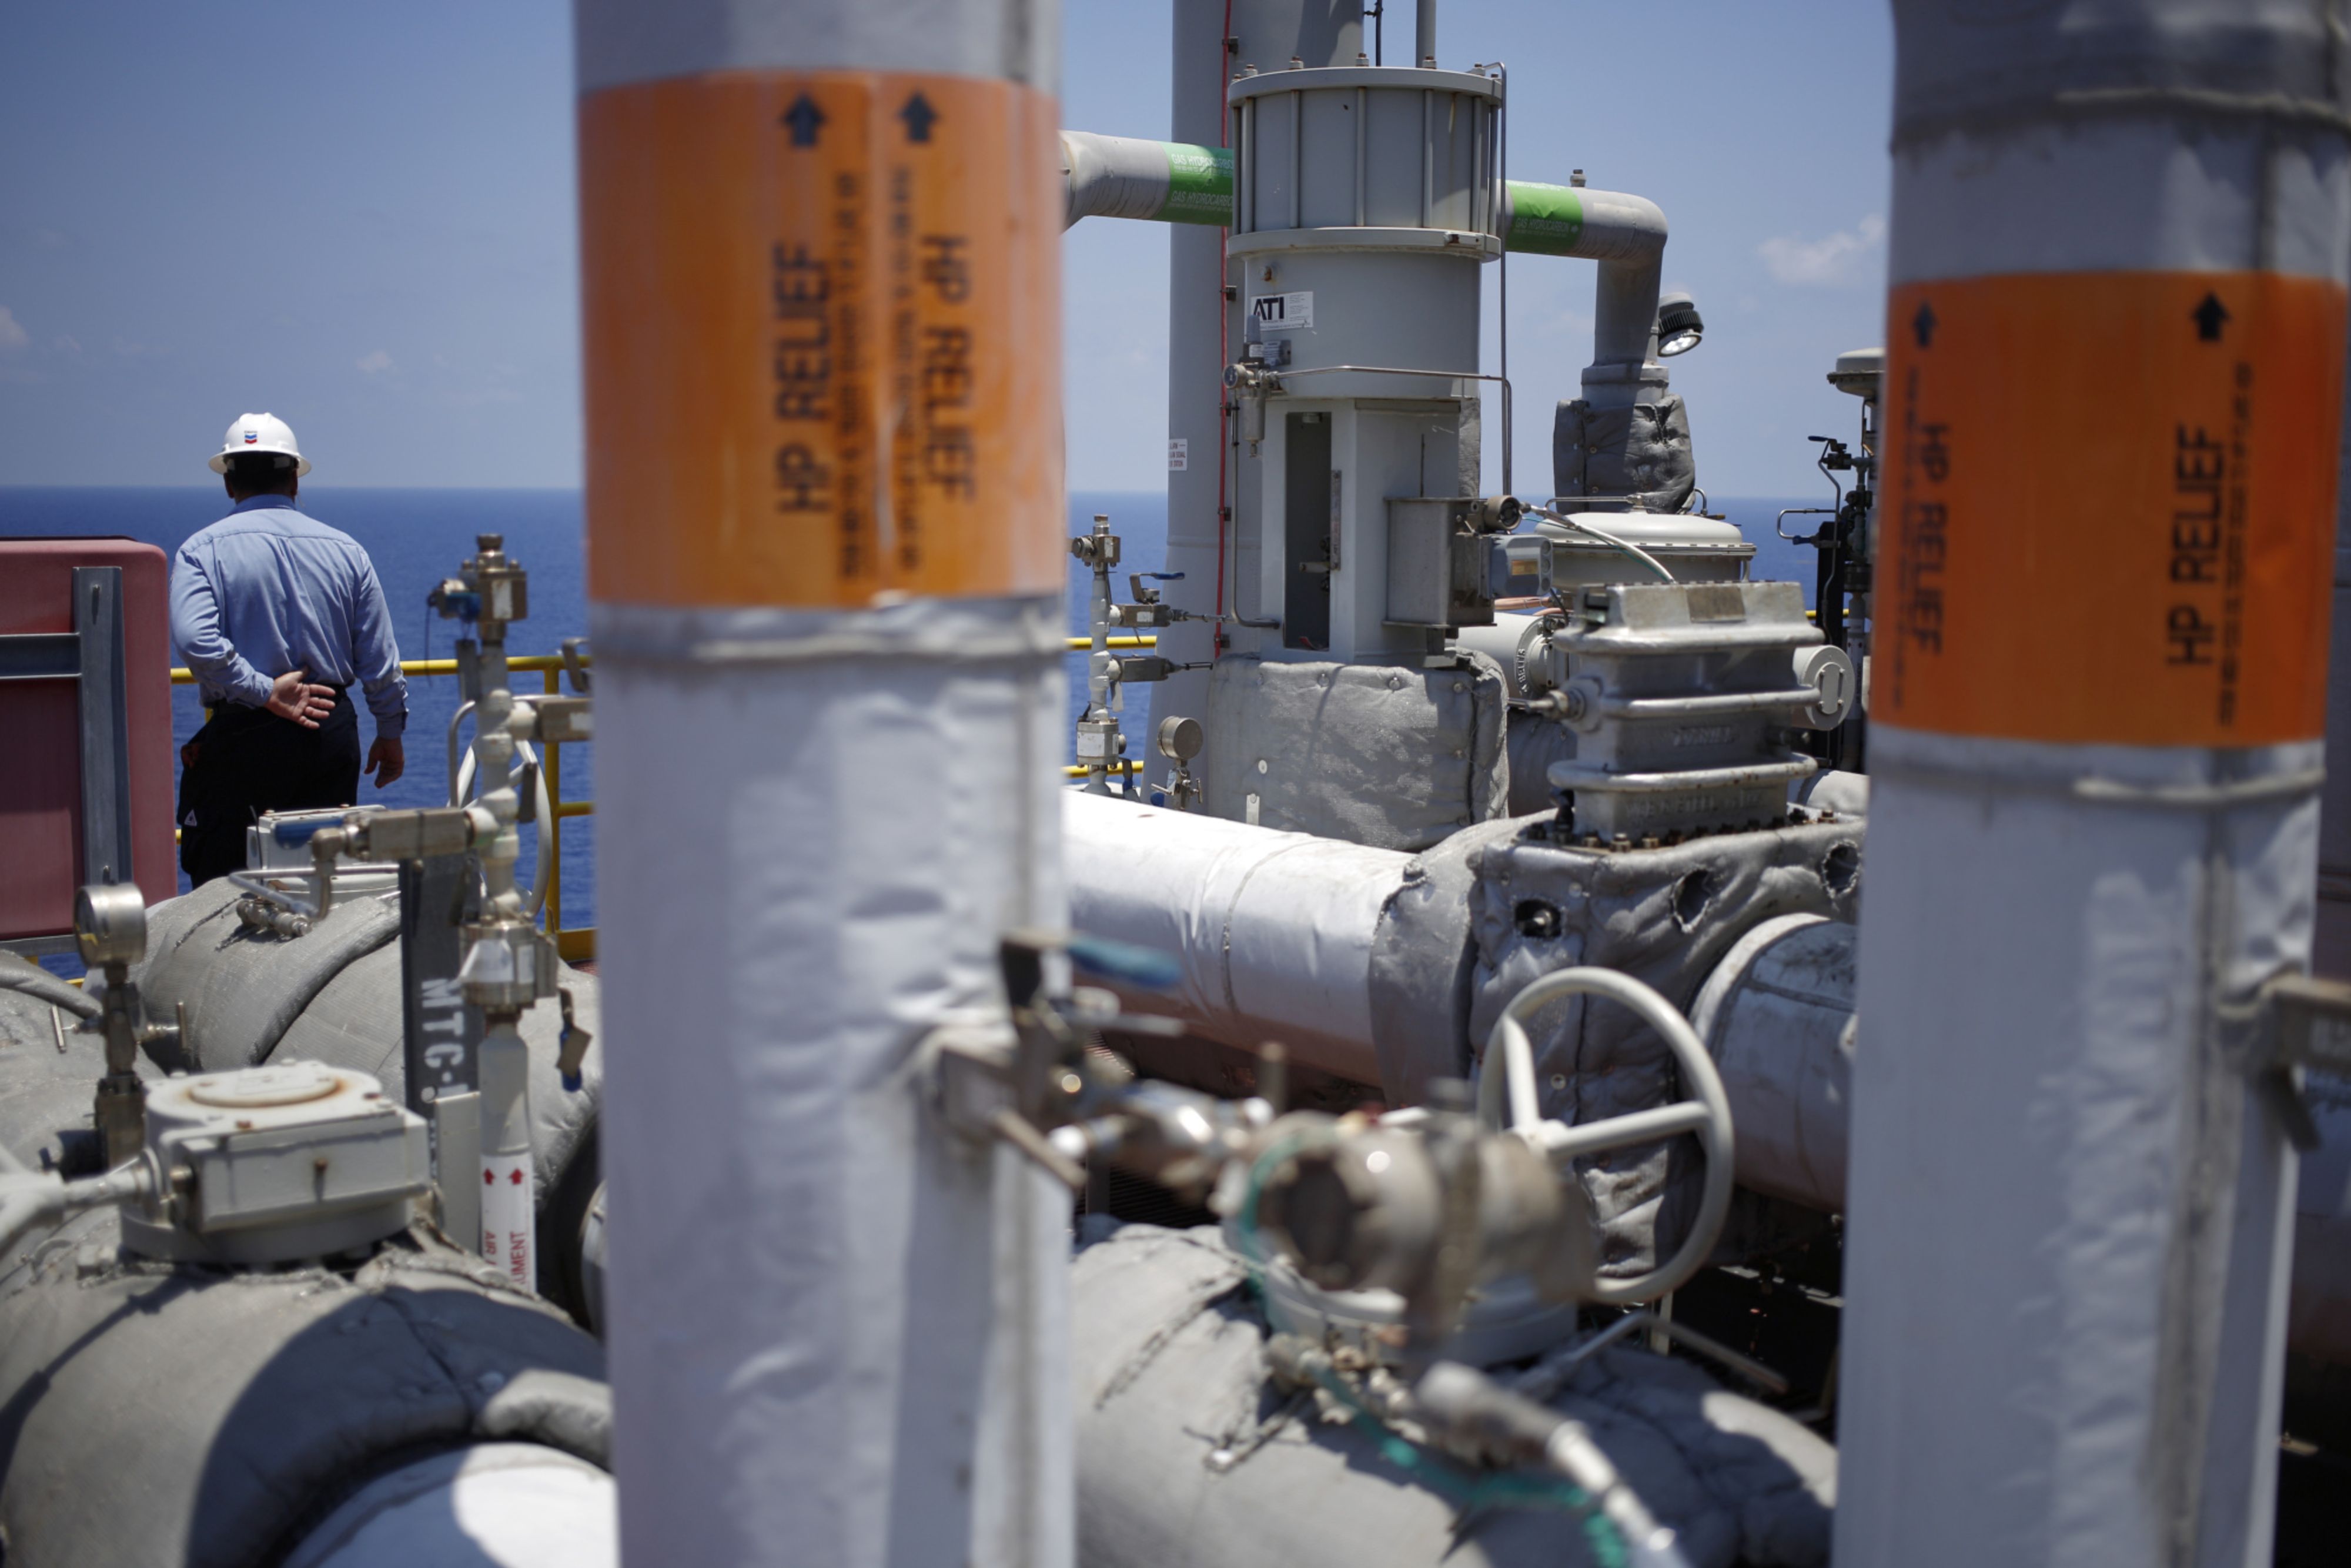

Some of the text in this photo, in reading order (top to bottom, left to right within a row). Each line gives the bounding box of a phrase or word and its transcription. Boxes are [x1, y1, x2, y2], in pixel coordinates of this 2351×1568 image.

[1171, 153, 1186, 165] GAS
[1172, 190, 1186, 203] GAS
[1253, 296, 1283, 320] ATI
[774, 240, 831, 515] HP RELIEF
[921, 236, 975, 504] HP RELIEF
[1911, 423, 1949, 657] HP RELIEF
[2166, 423, 2224, 667] HP RELIEF
[484, 1230, 497, 1255] AIR
[509, 1231, 527, 1285] UMENT
